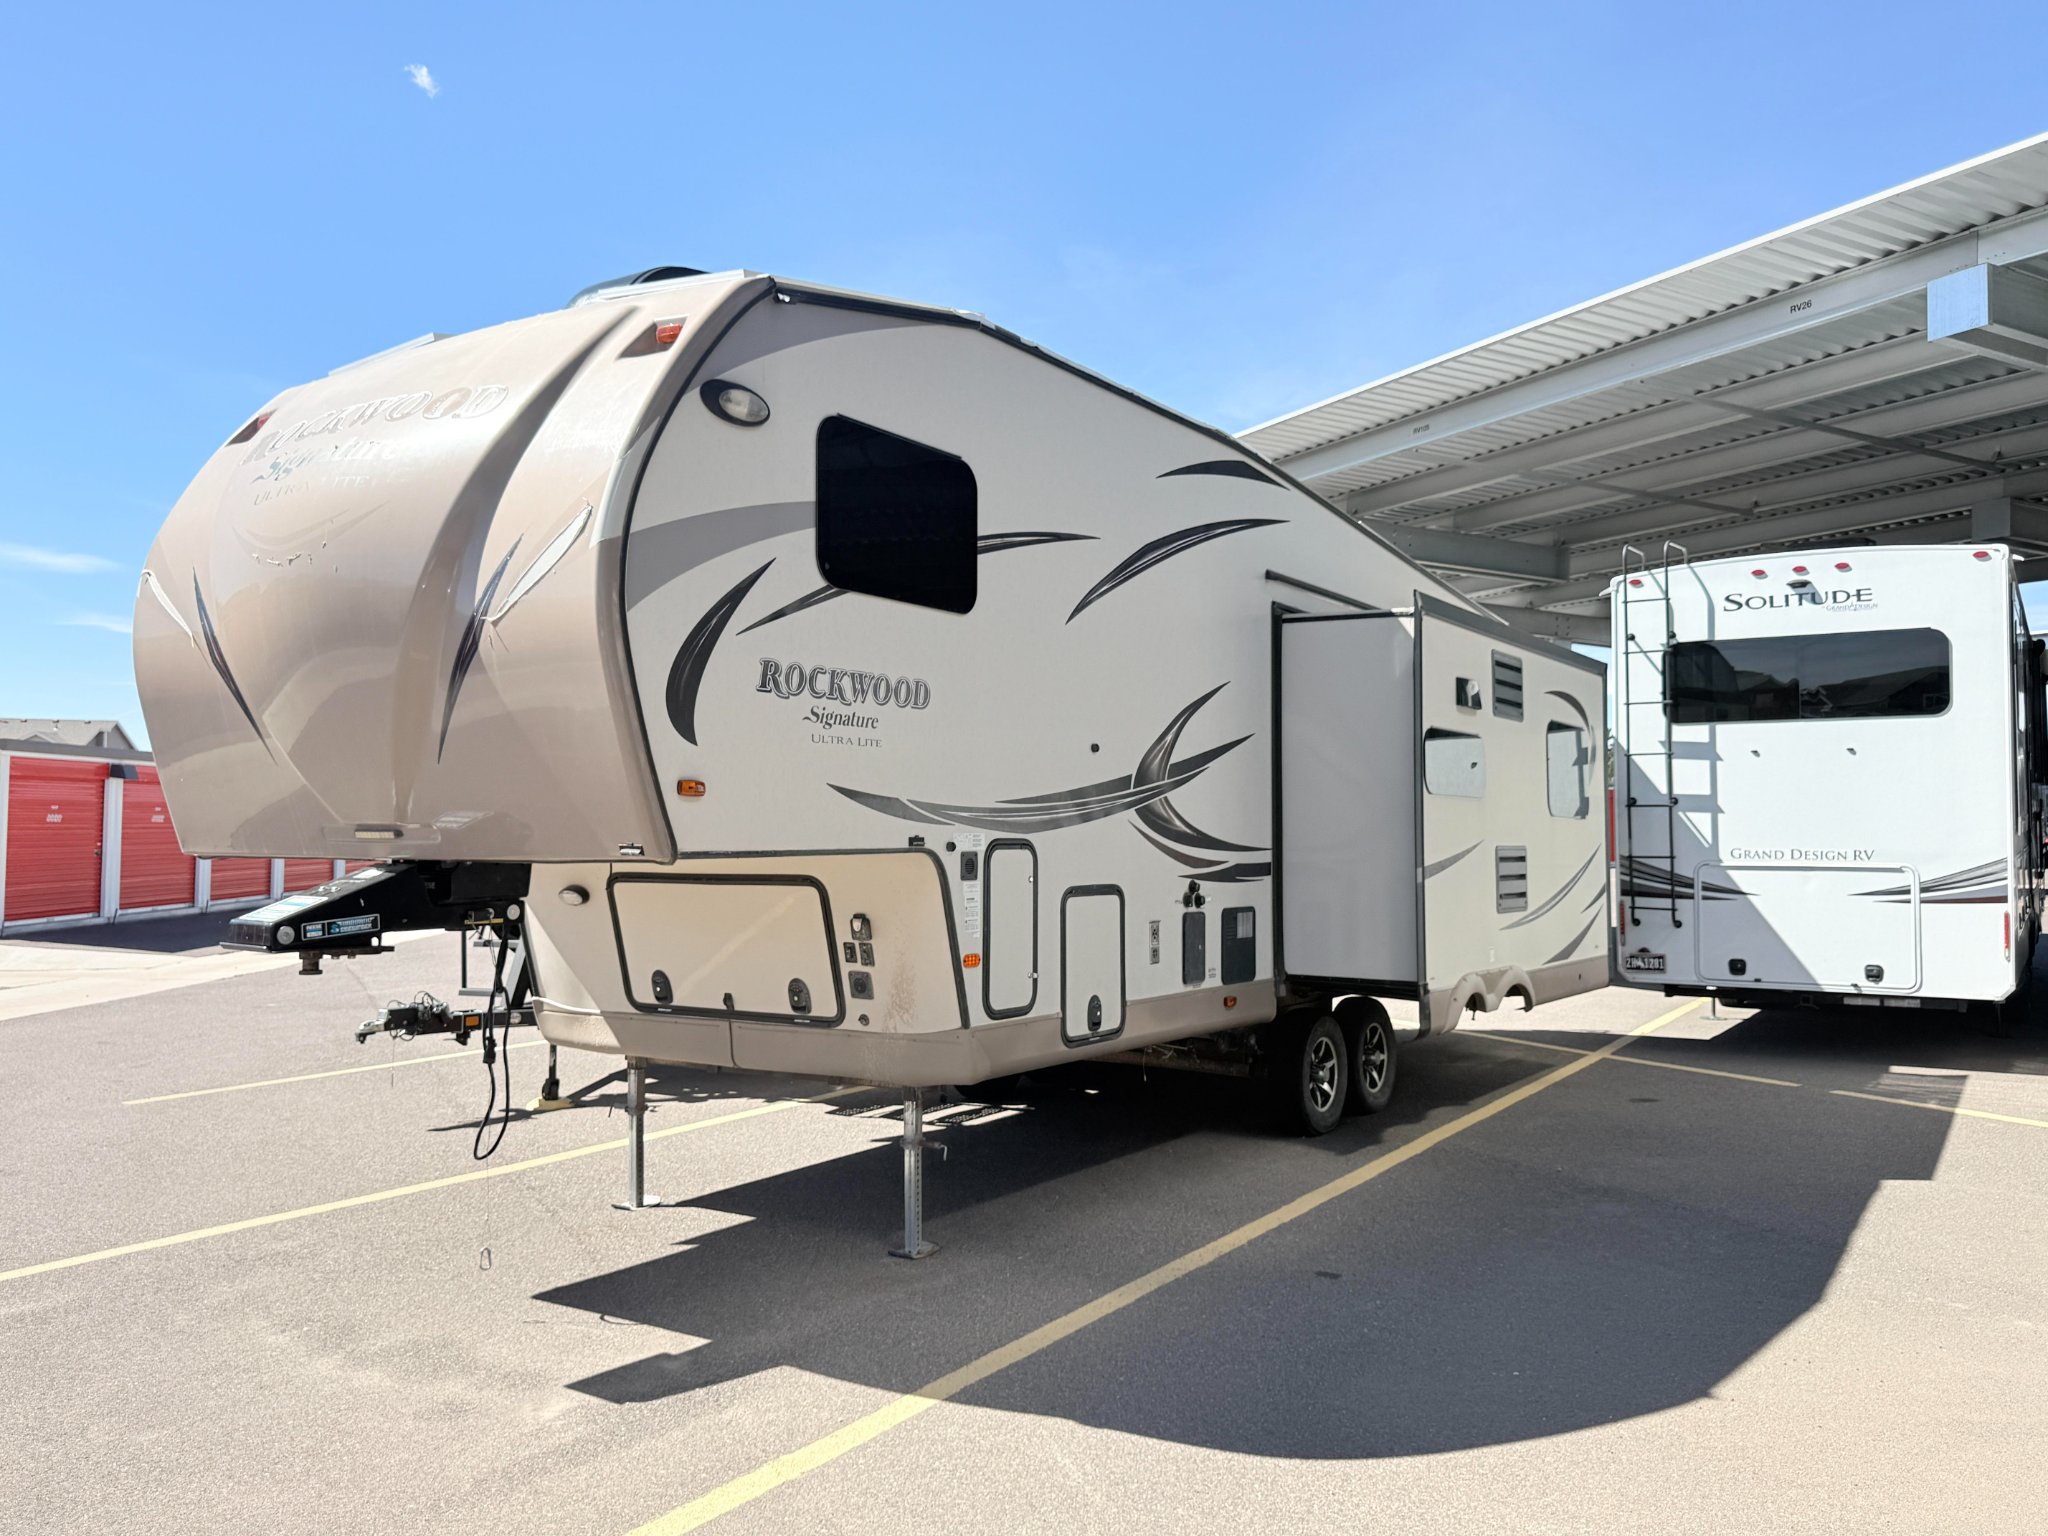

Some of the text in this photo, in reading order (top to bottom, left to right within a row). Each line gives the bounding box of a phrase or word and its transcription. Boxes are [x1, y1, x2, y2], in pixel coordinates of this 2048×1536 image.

[1790, 299, 1812, 314] RV26
[1723, 587, 1873, 612] SOLITUDE
[756, 657, 931, 710] ROCKWOOD
[802, 704, 879, 730] Signature
[810, 733, 882, 748] ULTRA LITE
[1730, 847, 1875, 861] GRAND DESIGN RV
